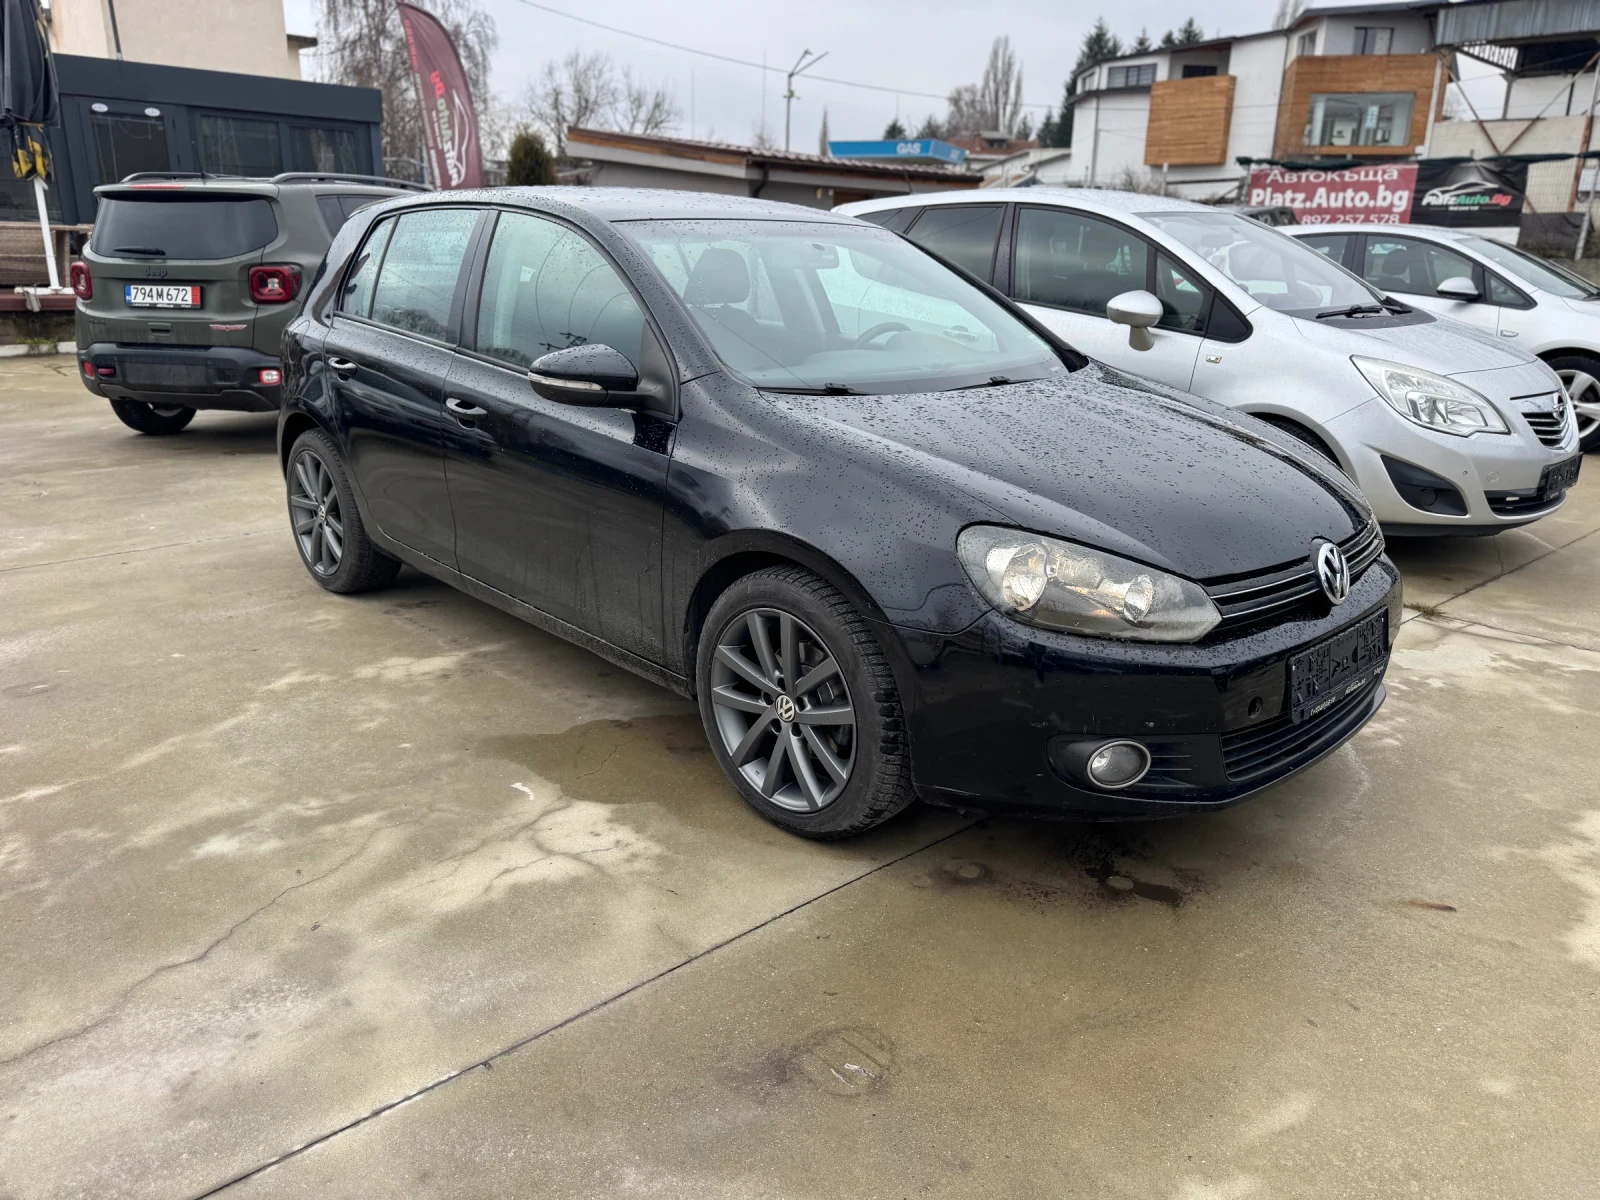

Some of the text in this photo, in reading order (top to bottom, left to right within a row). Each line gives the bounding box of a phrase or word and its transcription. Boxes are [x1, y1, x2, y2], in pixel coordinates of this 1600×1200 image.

[896, 142, 921, 154] GAS
[1266, 168, 1398, 183] Автокъща
[1251, 184, 1409, 212] Platz.Auto.bg
[1302, 213, 1400, 225] 897 257 578
